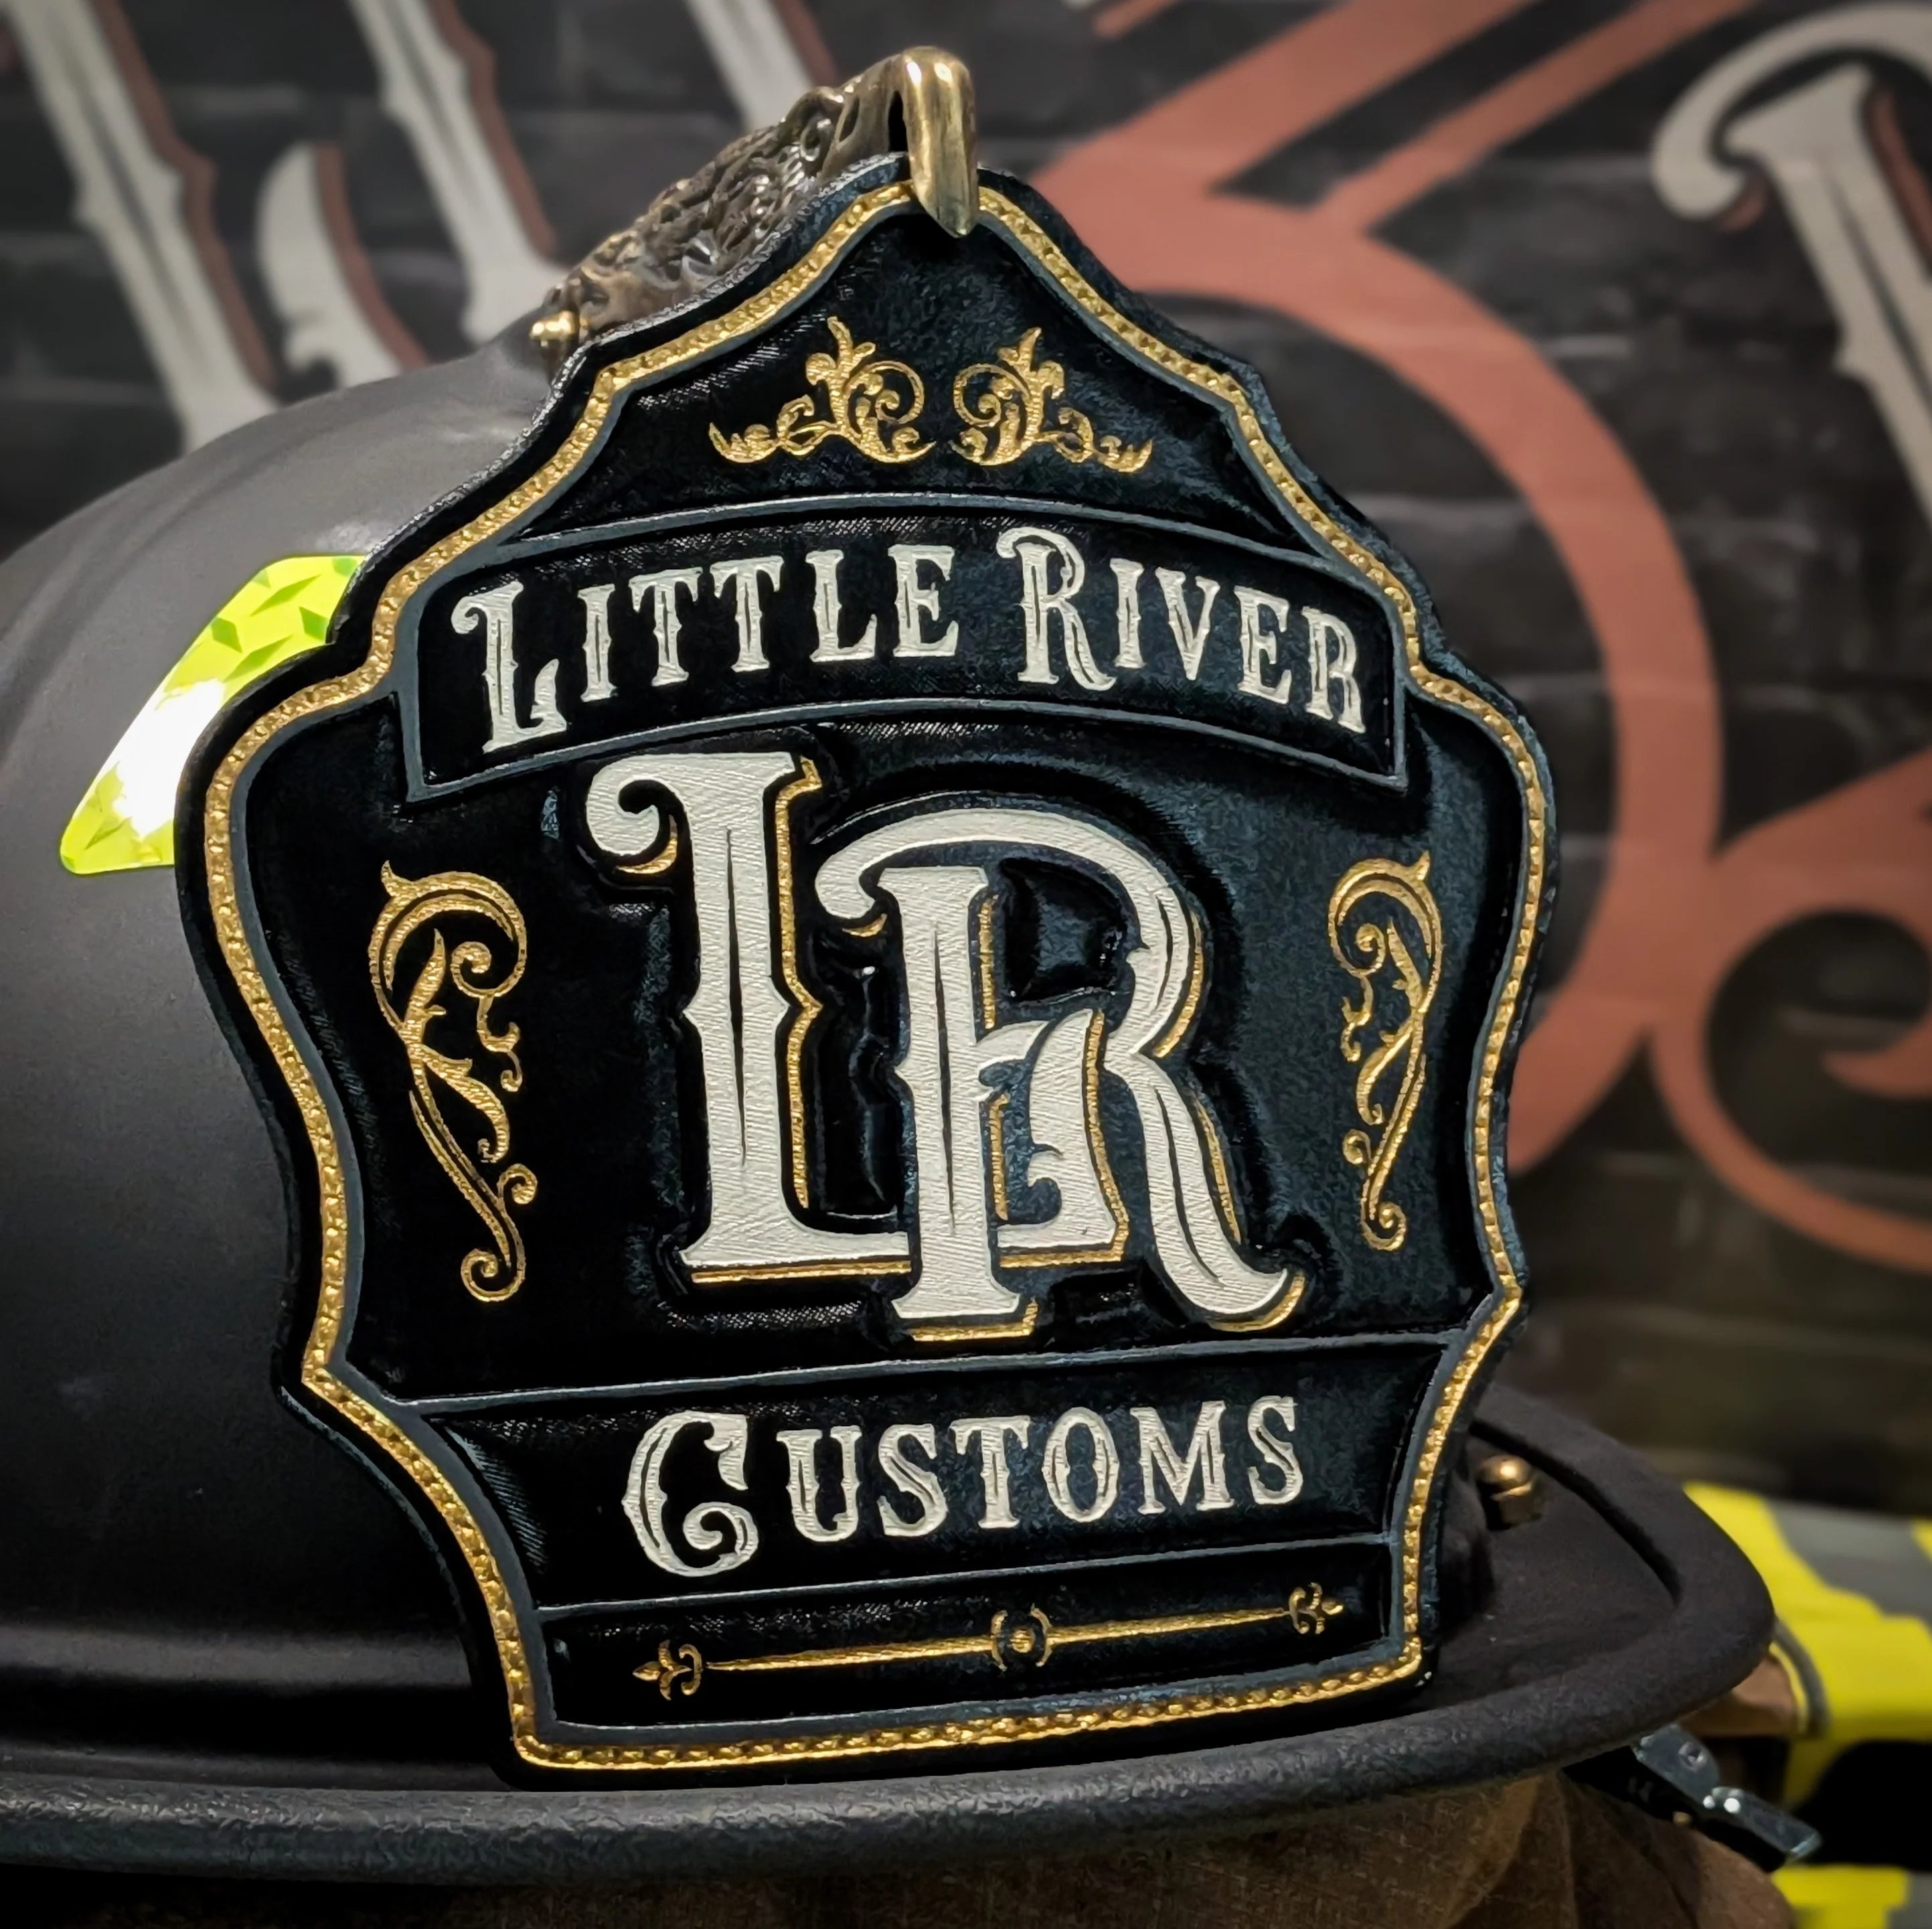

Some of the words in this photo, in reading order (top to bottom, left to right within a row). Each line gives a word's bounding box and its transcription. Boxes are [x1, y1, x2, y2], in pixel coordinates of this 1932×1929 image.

[451, 543, 959, 753] LITTLE
[996, 527, 1364, 734] RIVER
[585, 751, 1305, 1341] LR
[621, 1395, 1304, 1577] CUSTOMS
